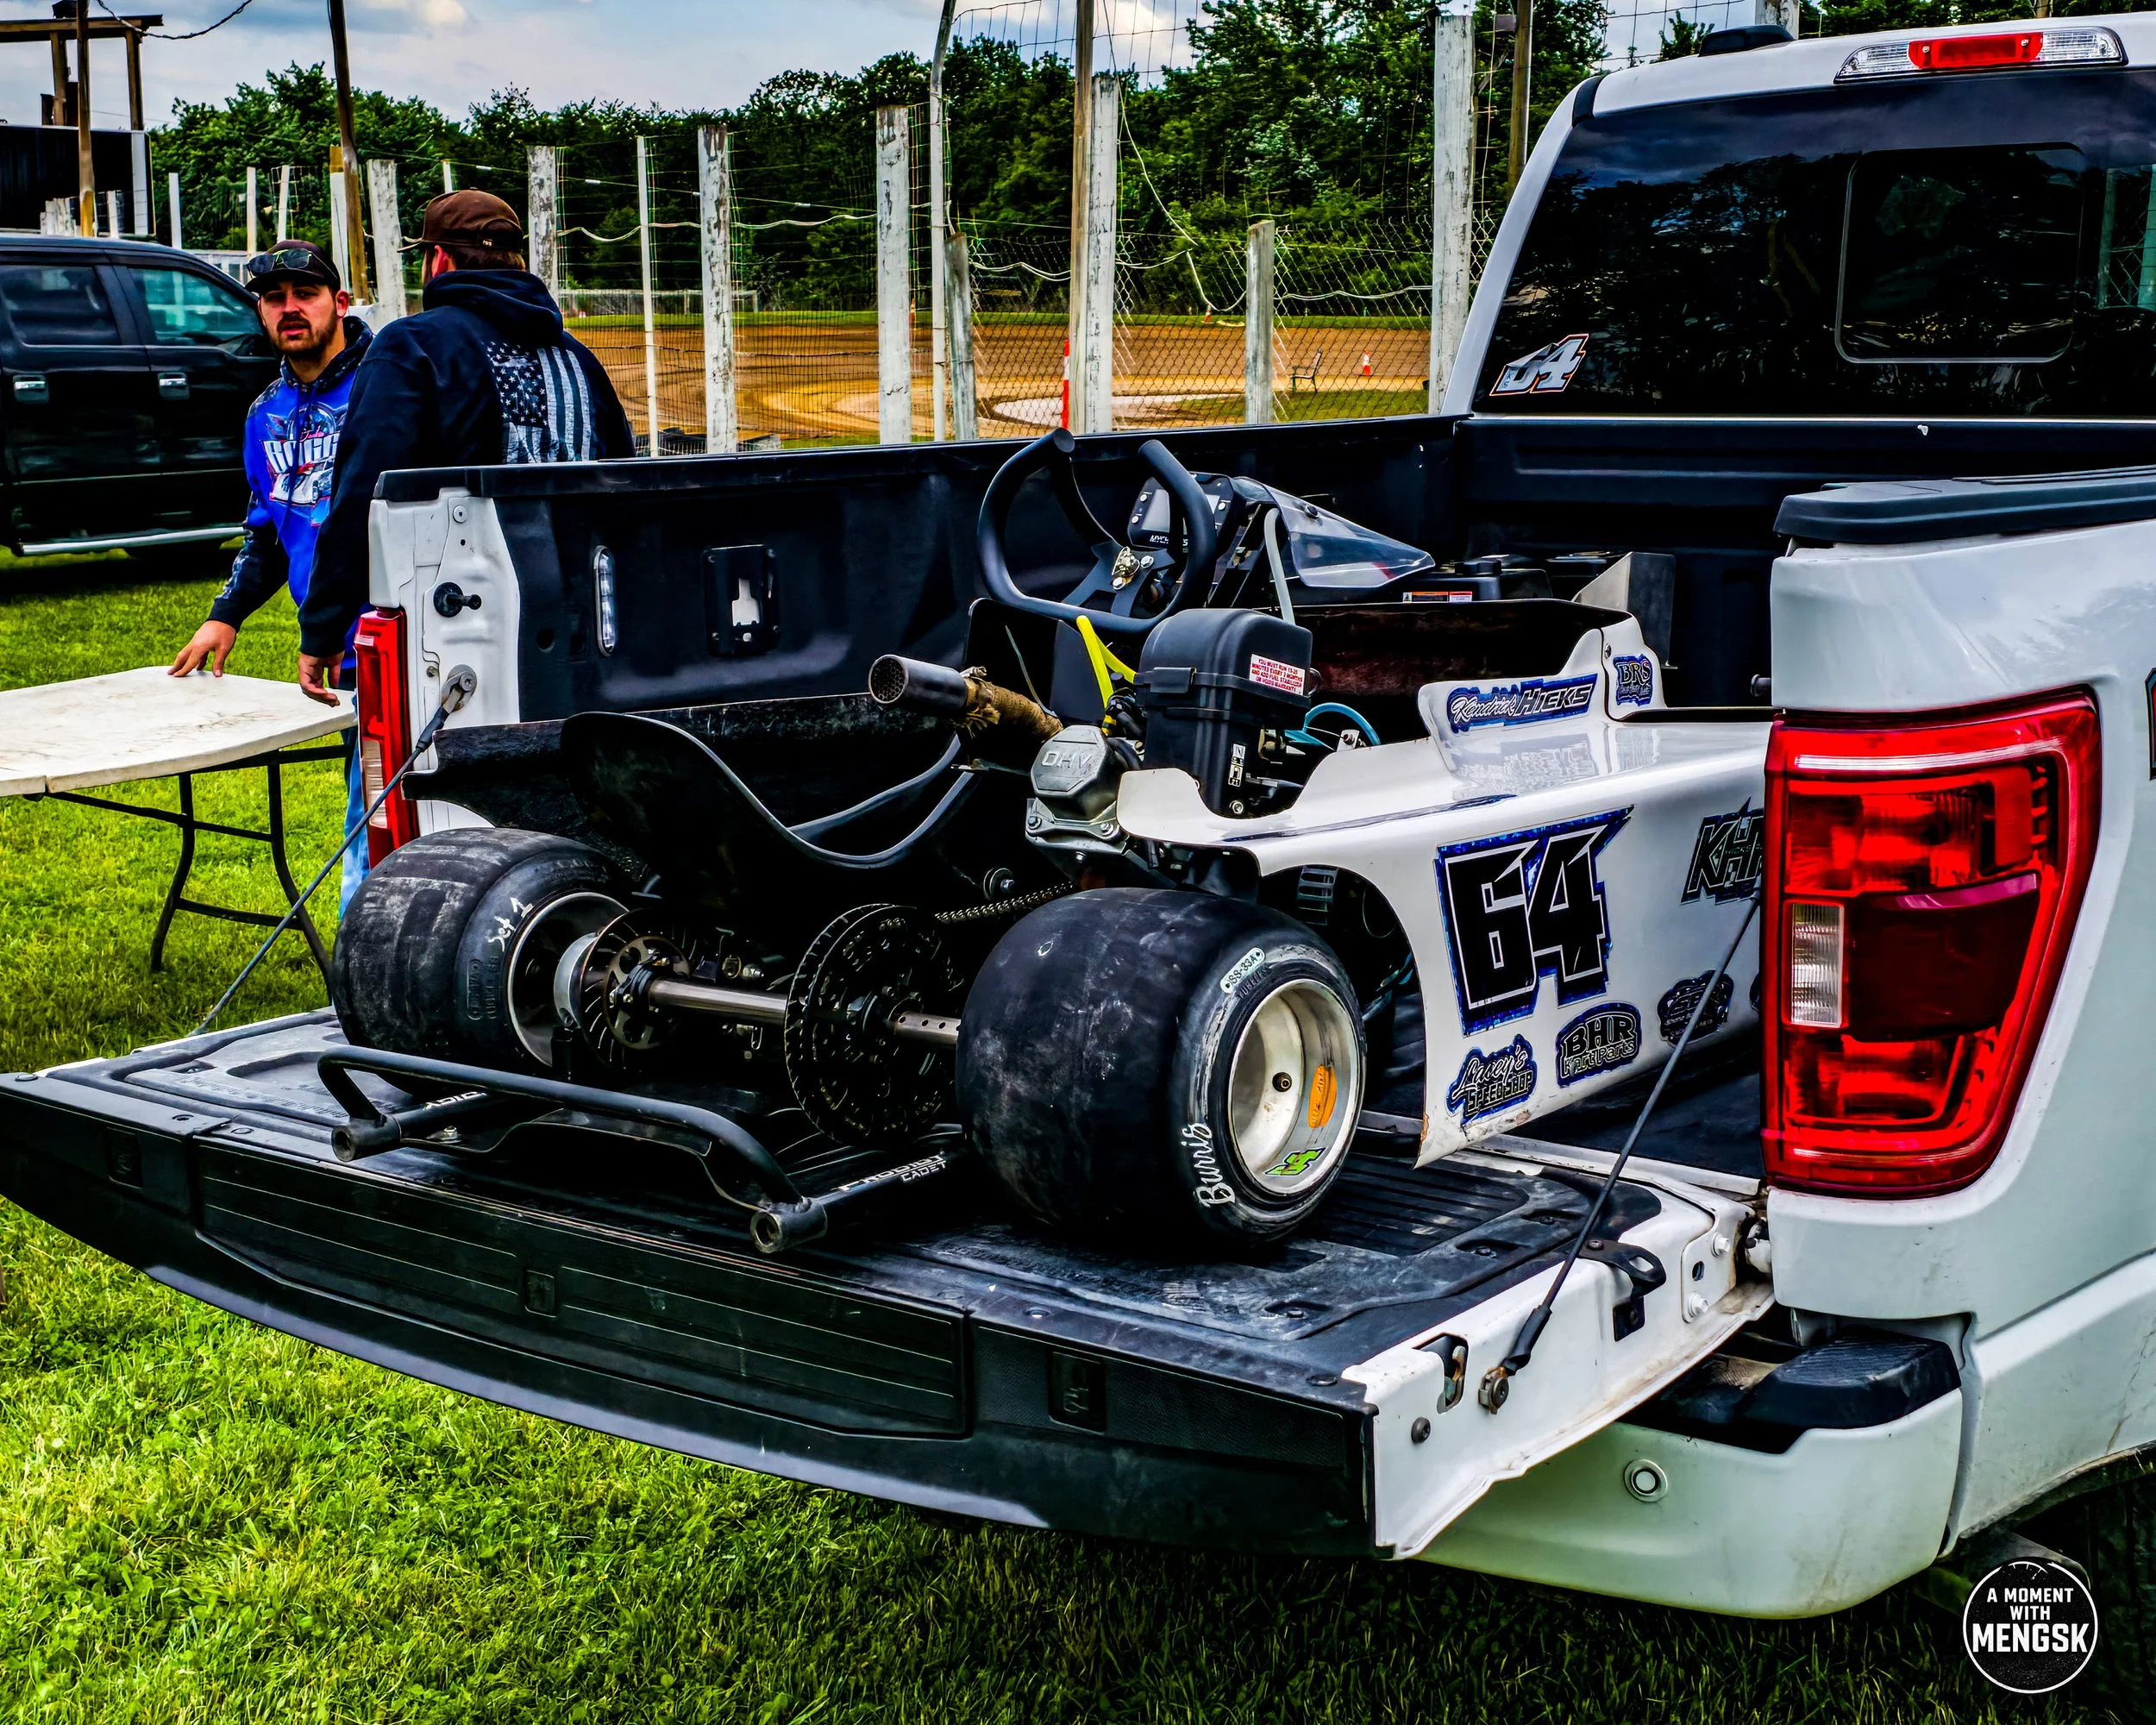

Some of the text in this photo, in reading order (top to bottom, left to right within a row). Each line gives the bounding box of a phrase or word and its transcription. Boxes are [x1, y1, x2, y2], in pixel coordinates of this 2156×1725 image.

[1615, 659, 1651, 685] BRS
[1451, 683, 1594, 724] Kendrick HICKS
[1041, 750, 1094, 769] OHV
[1445, 824, 1613, 1010] 64
[1228, 954, 1258, 984] SS-33A
[1563, 1013, 1635, 1059] BHR
[1467, 1082, 1503, 1113] SPEED
[900, 1160, 947, 1182] CADET
[1181, 1122, 1236, 1208] Burris
